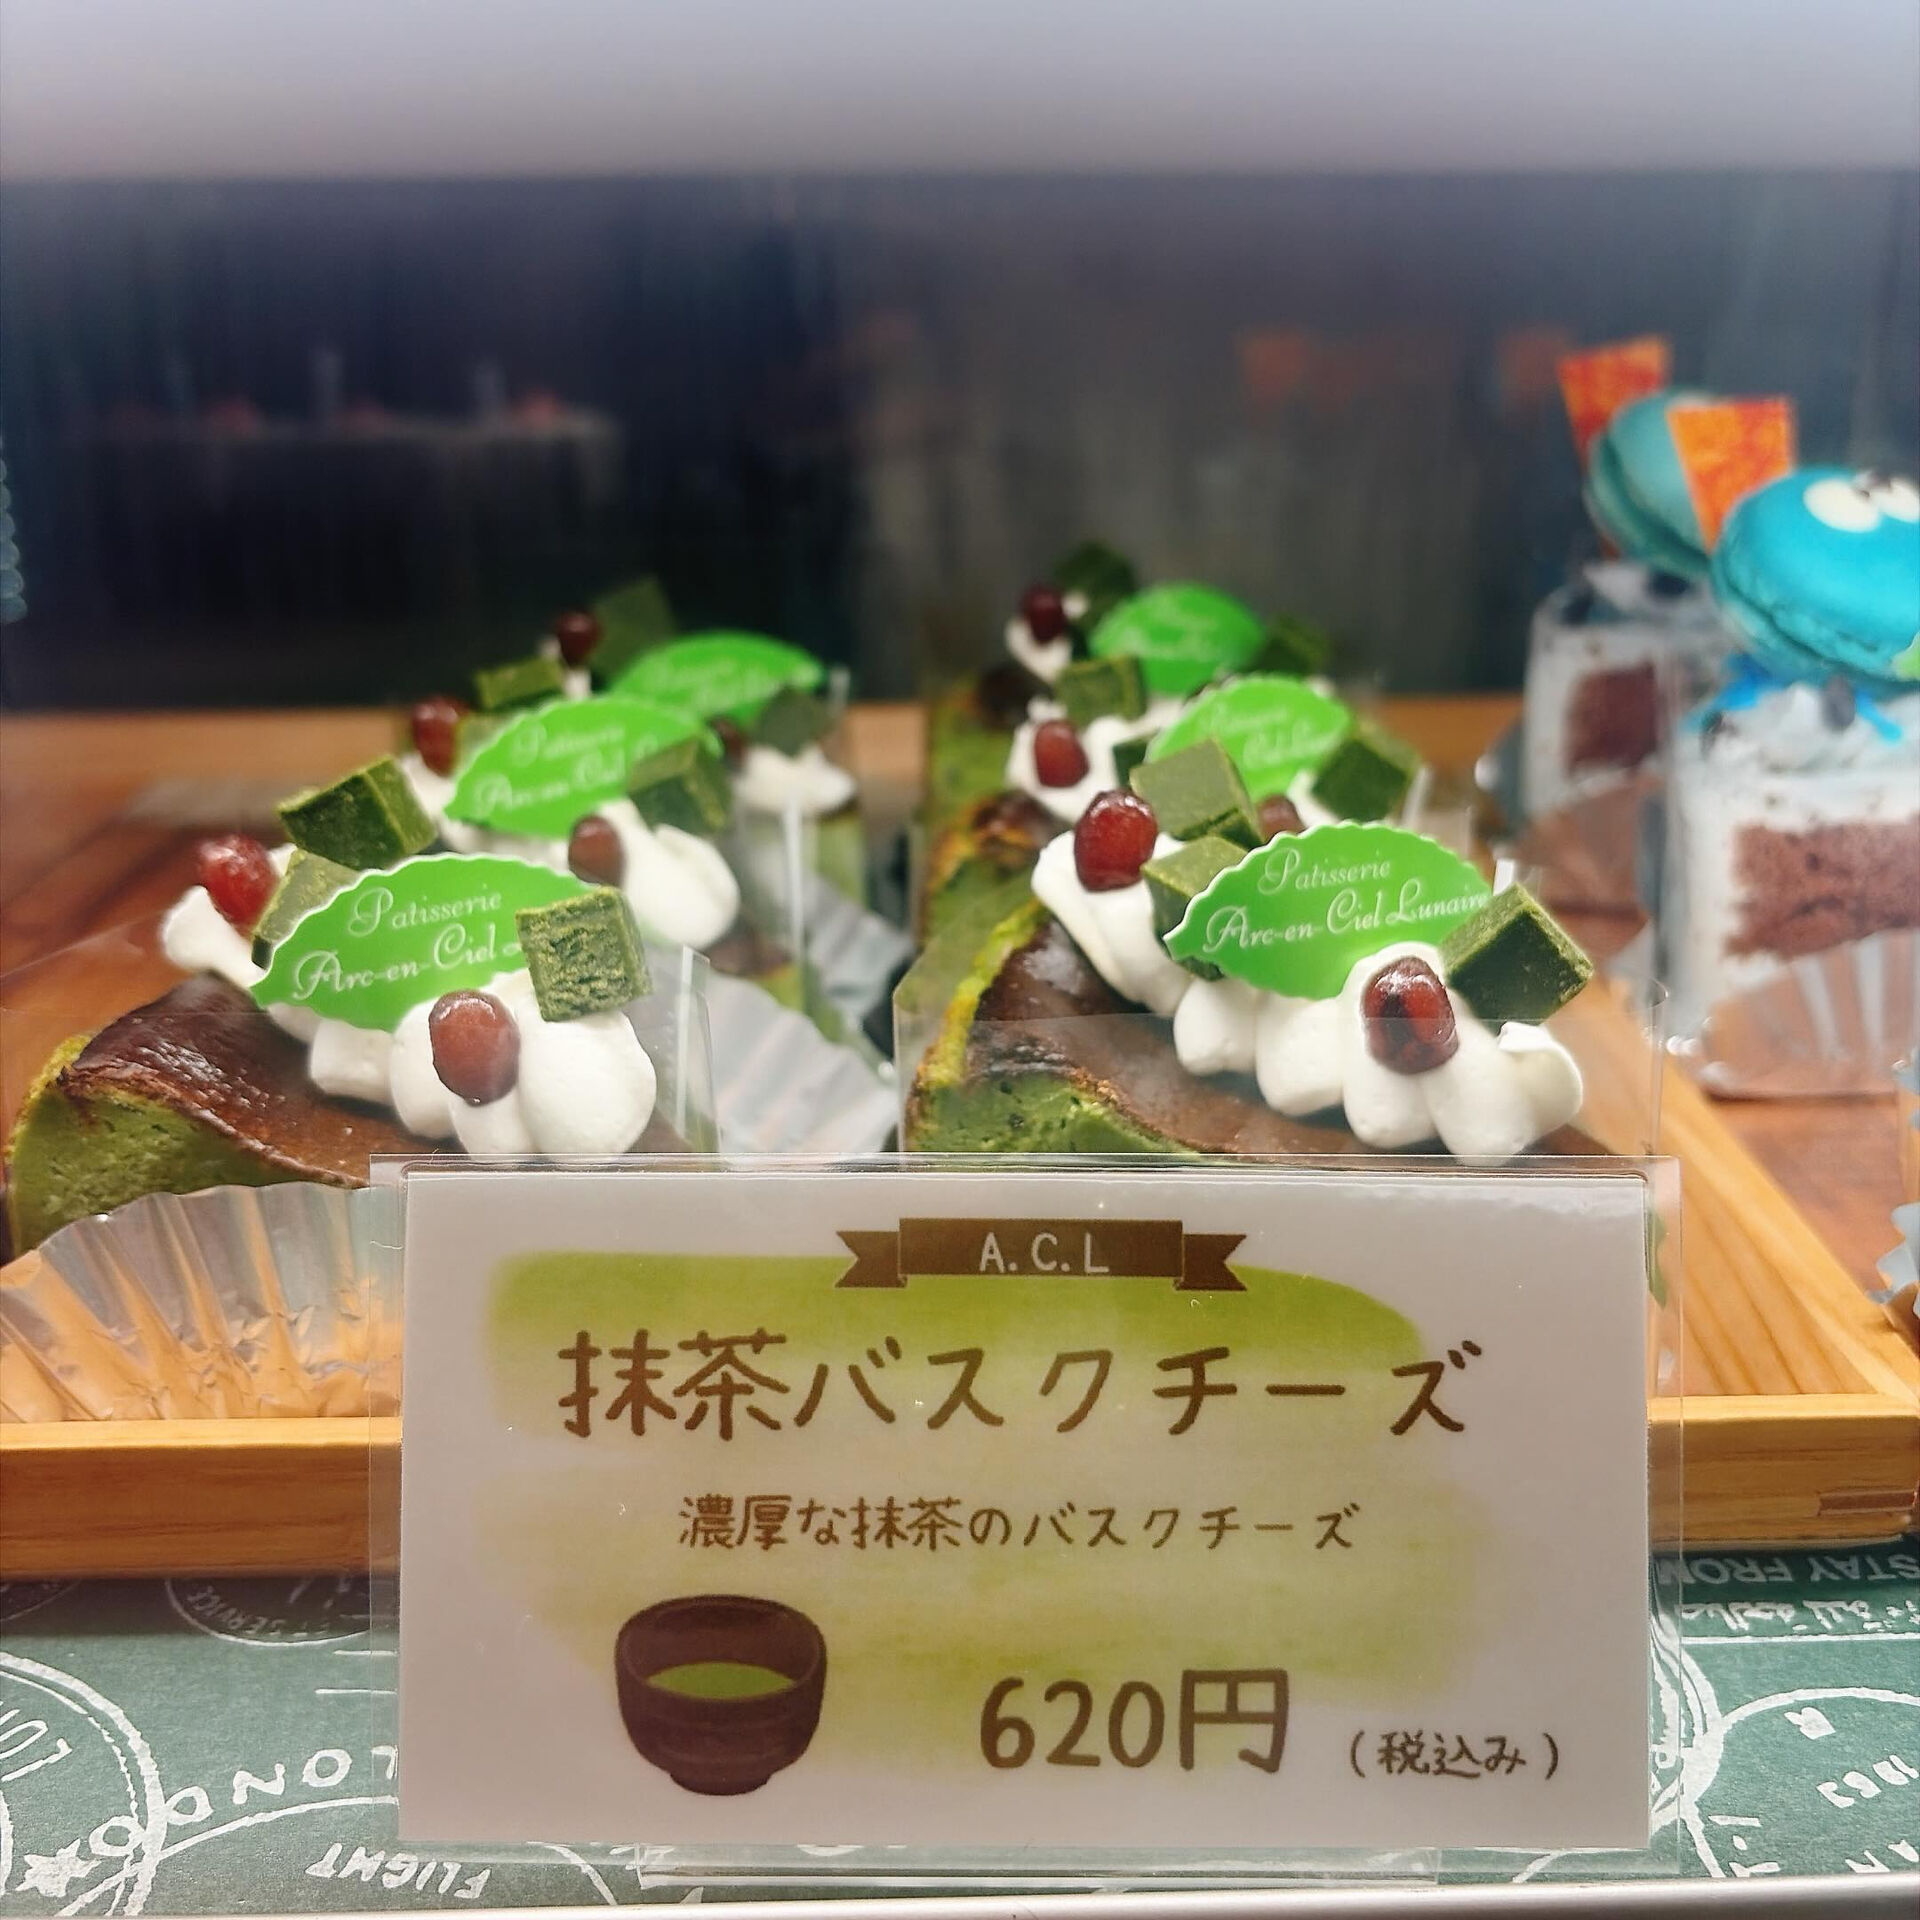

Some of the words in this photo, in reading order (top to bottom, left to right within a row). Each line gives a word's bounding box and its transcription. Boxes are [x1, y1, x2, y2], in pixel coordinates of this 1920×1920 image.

[1257, 849, 1392, 895] Patisserie
[348, 883, 502, 937] Patisserie
[980, 1233, 1110, 1274] A.C.L
[558, 1328, 1484, 1442] 抹茶バスクチーズ
[678, 1493, 1361, 1553] 濃厚な抹茶のバスクチーズ
[980, 1669, 1290, 1774] 620円
[305, 1842, 492, 1899] FLIGHT
